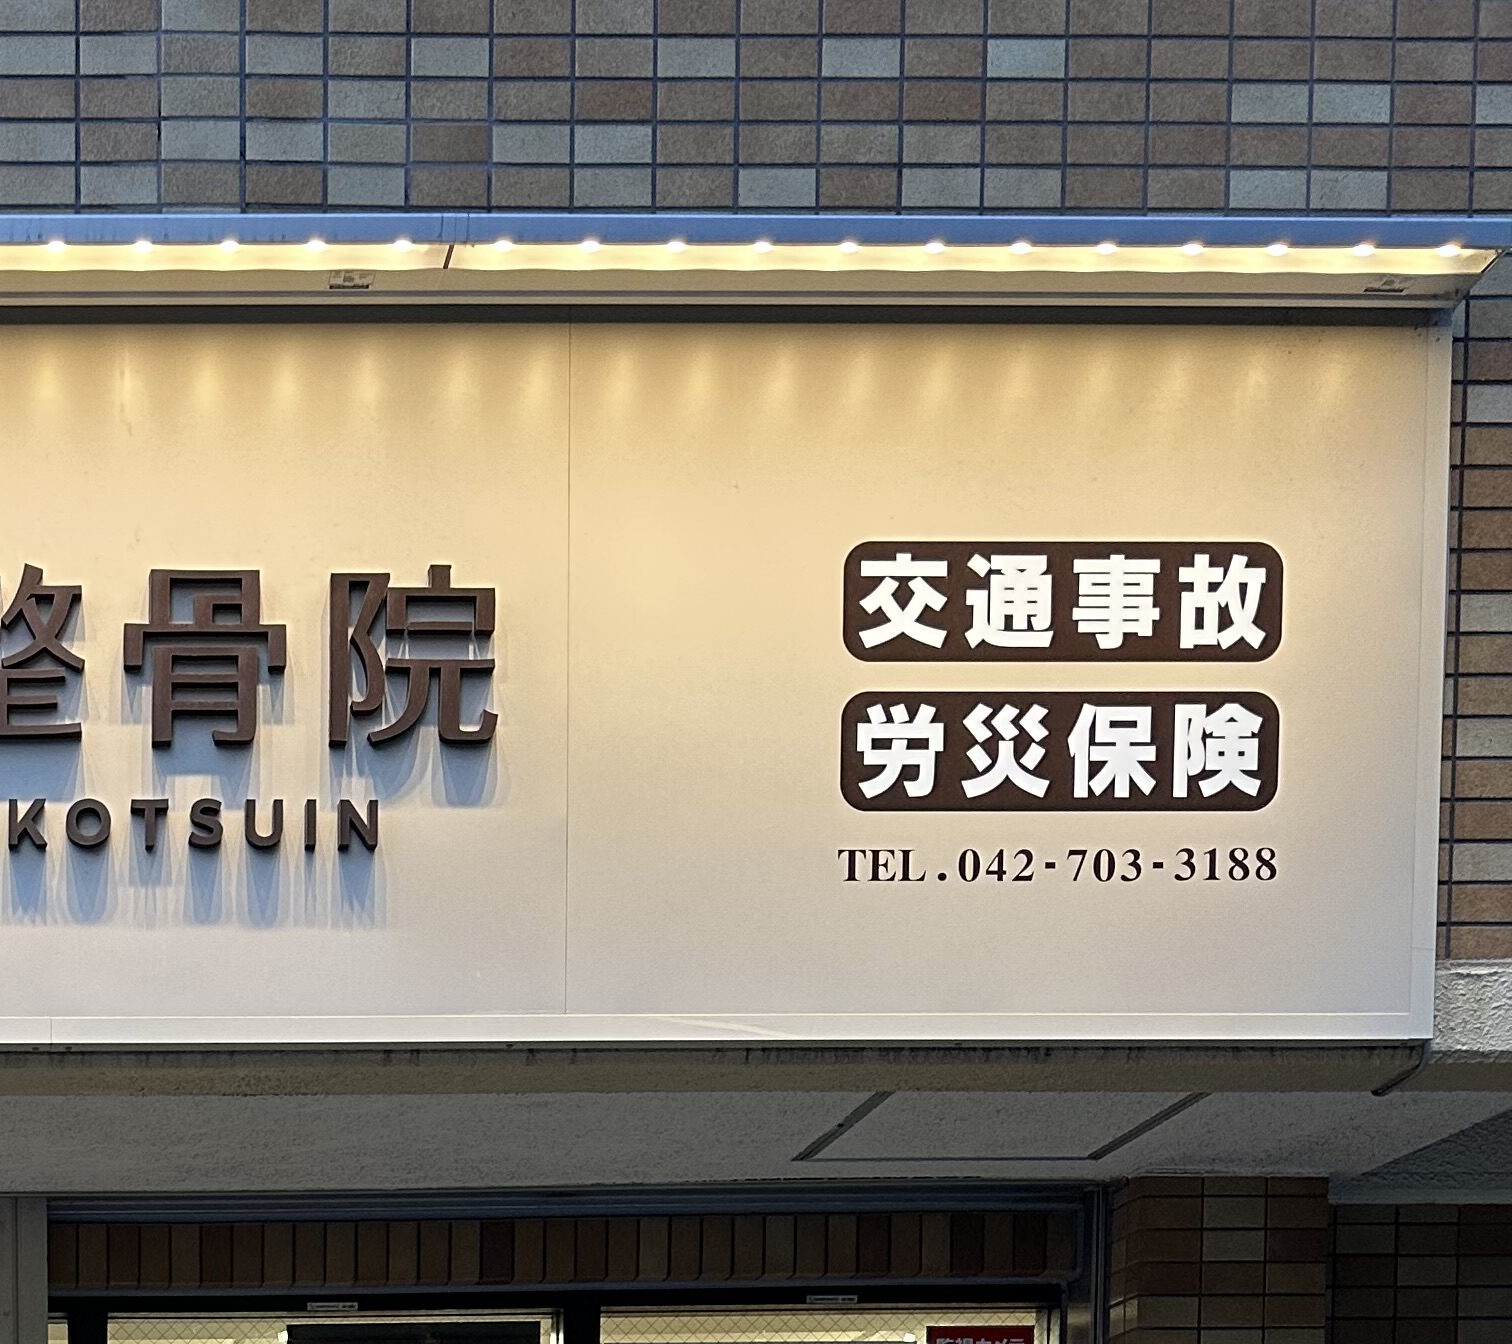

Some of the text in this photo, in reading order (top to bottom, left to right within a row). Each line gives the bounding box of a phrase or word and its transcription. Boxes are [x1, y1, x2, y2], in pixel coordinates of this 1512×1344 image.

[859, 552, 1267, 650] 交通事故
[856, 702, 1264, 799] 労災保険
